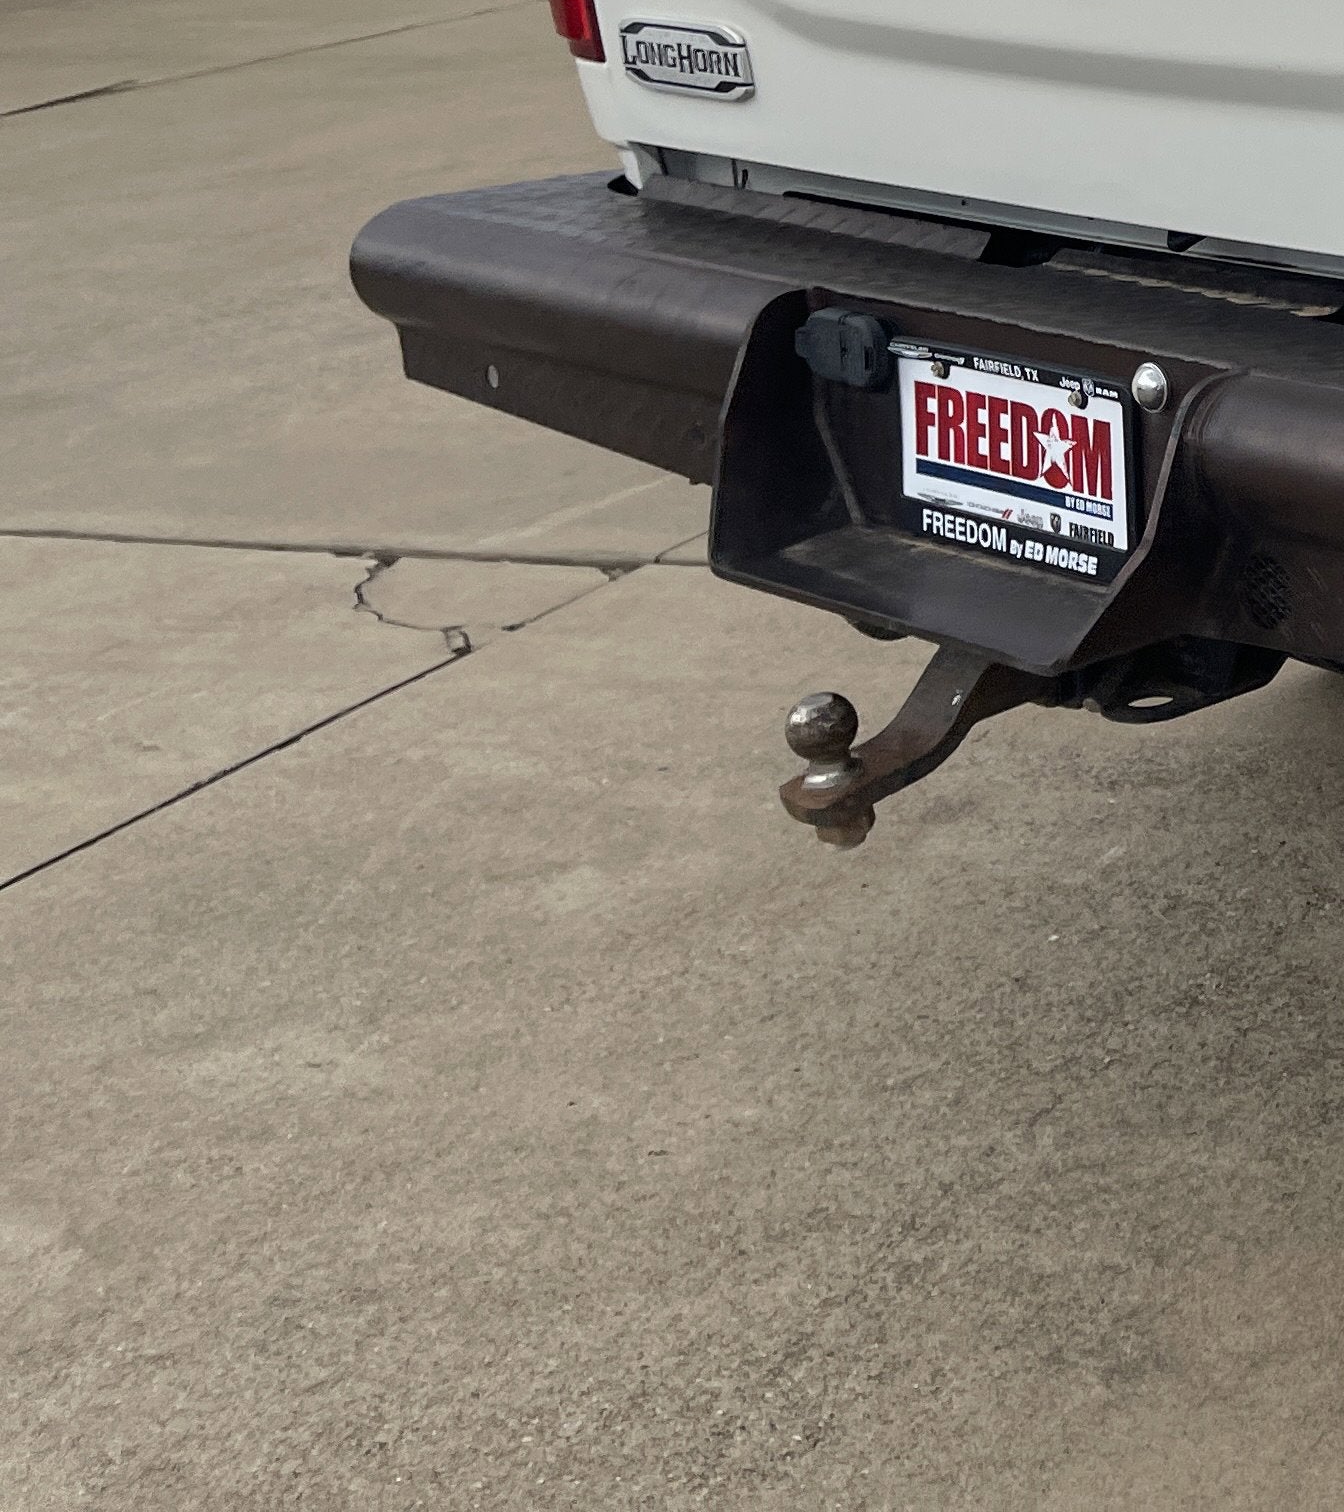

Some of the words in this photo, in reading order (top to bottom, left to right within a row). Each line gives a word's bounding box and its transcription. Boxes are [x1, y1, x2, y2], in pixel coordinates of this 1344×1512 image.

[1024, 367, 1039, 382] TX
[914, 381, 1113, 500] FREEDOM
[1075, 498, 1085, 511] ED
[1085, 500, 1111, 518] MORSE
[922, 508, 1007, 552] FREEDOM
[1024, 539, 1044, 562] ED
[1045, 545, 1098, 576] MORSE
[1069, 522, 1114, 547] FAIRFIELD
